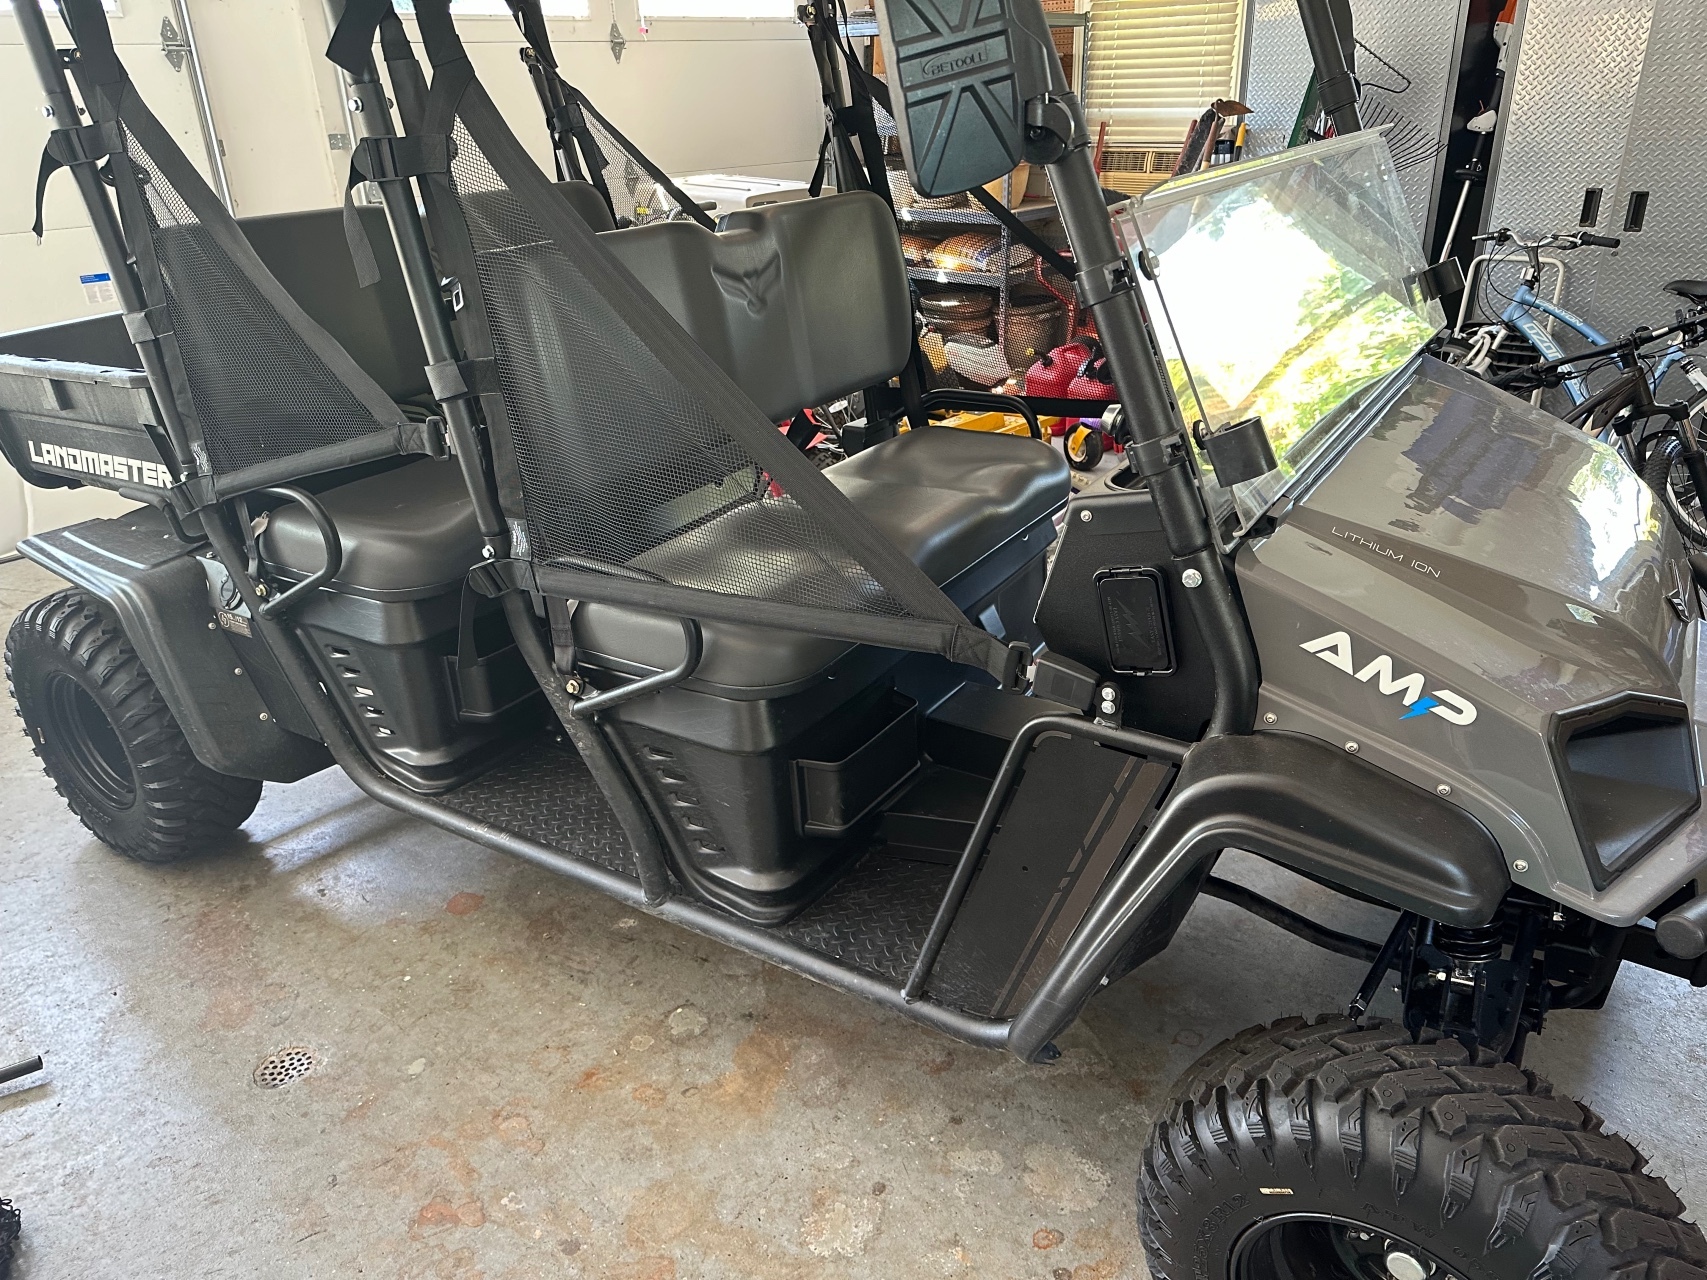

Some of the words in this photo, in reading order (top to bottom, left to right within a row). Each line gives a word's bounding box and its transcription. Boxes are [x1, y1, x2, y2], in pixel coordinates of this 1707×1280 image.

[28, 440, 173, 489] LANDMASTER
[1331, 526, 1404, 562] LITHIUM
[1411, 559, 1441, 578] ION
[1298, 630, 1478, 726] AMP
